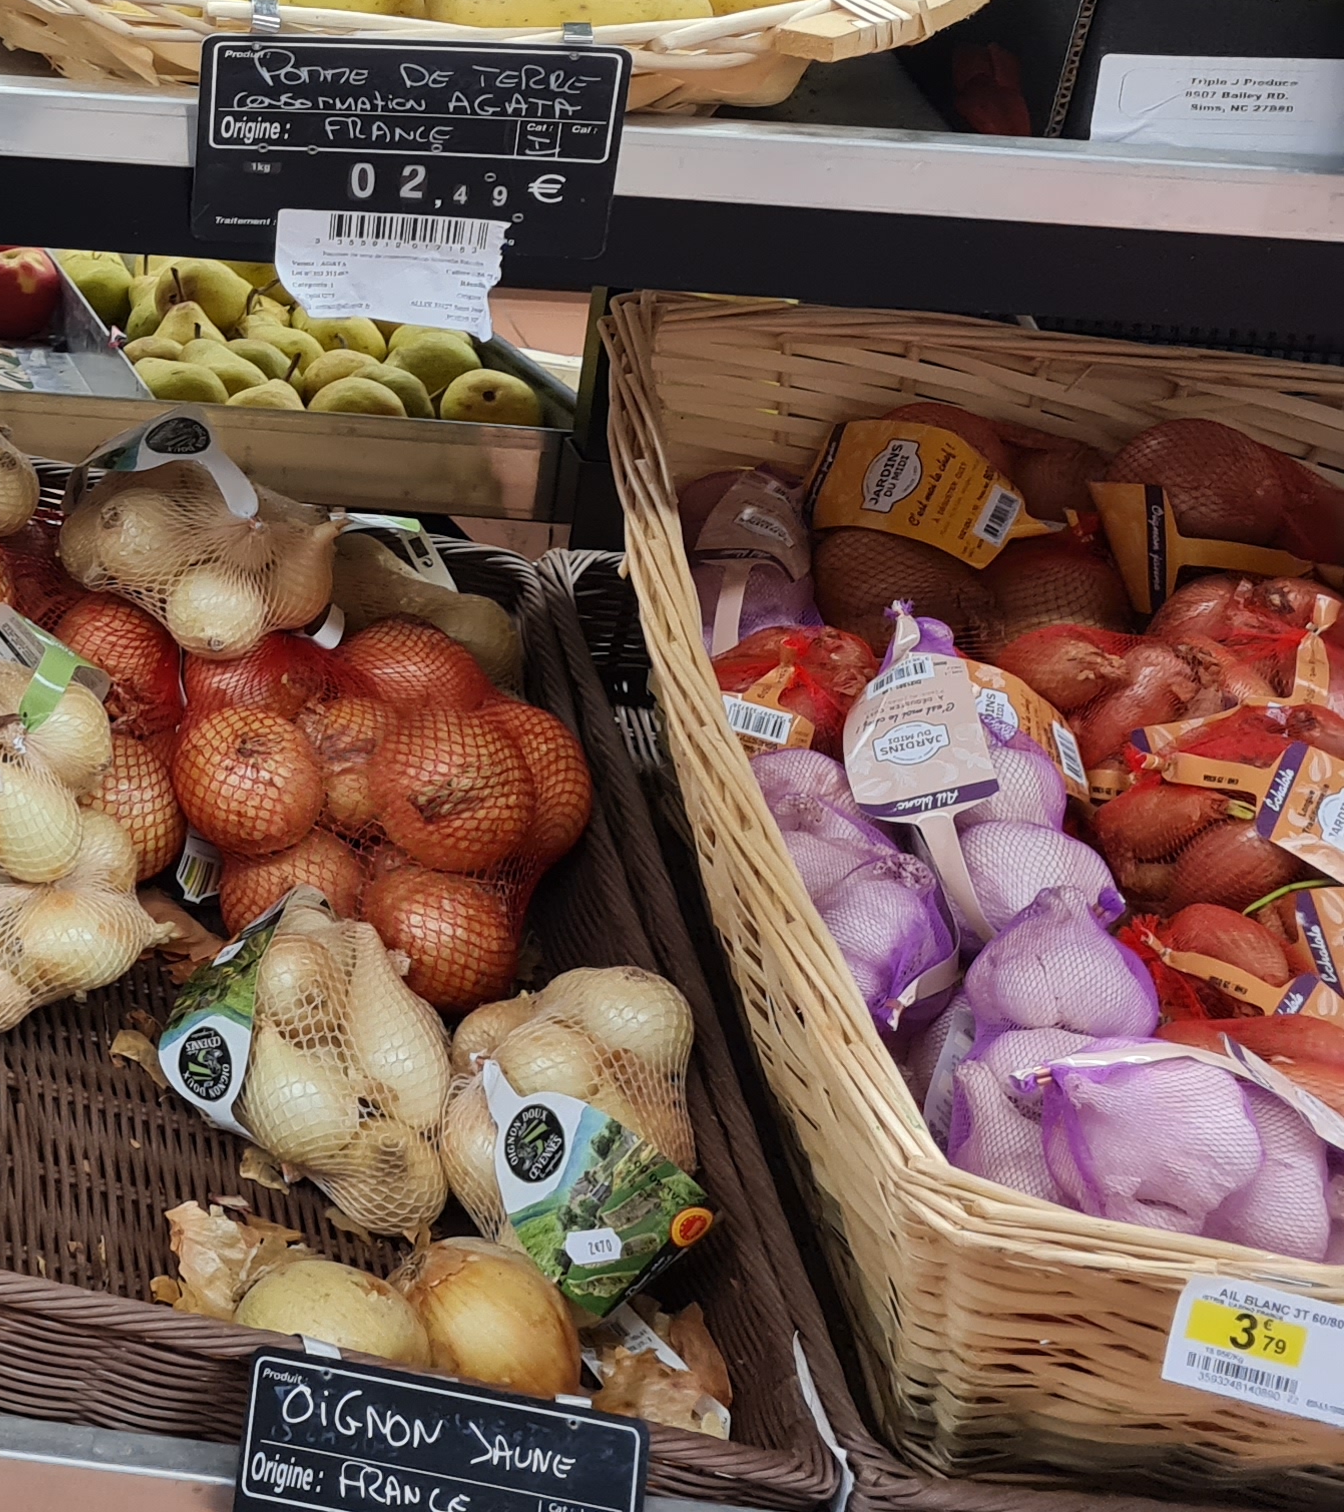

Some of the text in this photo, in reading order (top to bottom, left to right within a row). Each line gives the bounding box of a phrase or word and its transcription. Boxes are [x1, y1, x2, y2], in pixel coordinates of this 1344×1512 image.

[399, 62, 456, 89] DE
[472, 64, 602, 95] TERRE
[447, 92, 583, 117] AGATA
[1221, 90, 1263, 101] Bailey
[1230, 103, 1250, 113] NC
[324, 117, 455, 144] FRANCE
[251, 161, 271, 174] 1kg
[868, 443, 905, 506] JARDINS
[883, 454, 911, 499] DU MIDI
[879, 732, 944, 757] JARDINS
[887, 728, 933, 746] DU MIDI
[897, 790, 959, 812] Ail blanc
[182, 1069, 207, 1097] DOUX
[505, 1106, 549, 1167] OIGNON DOUX
[1219, 1288, 1240, 1303] AIL
[1244, 1294, 1291, 1316] BLANC
[469, 1420, 577, 1480] JAUNE
[338, 1460, 472, 1512] FRANCE
